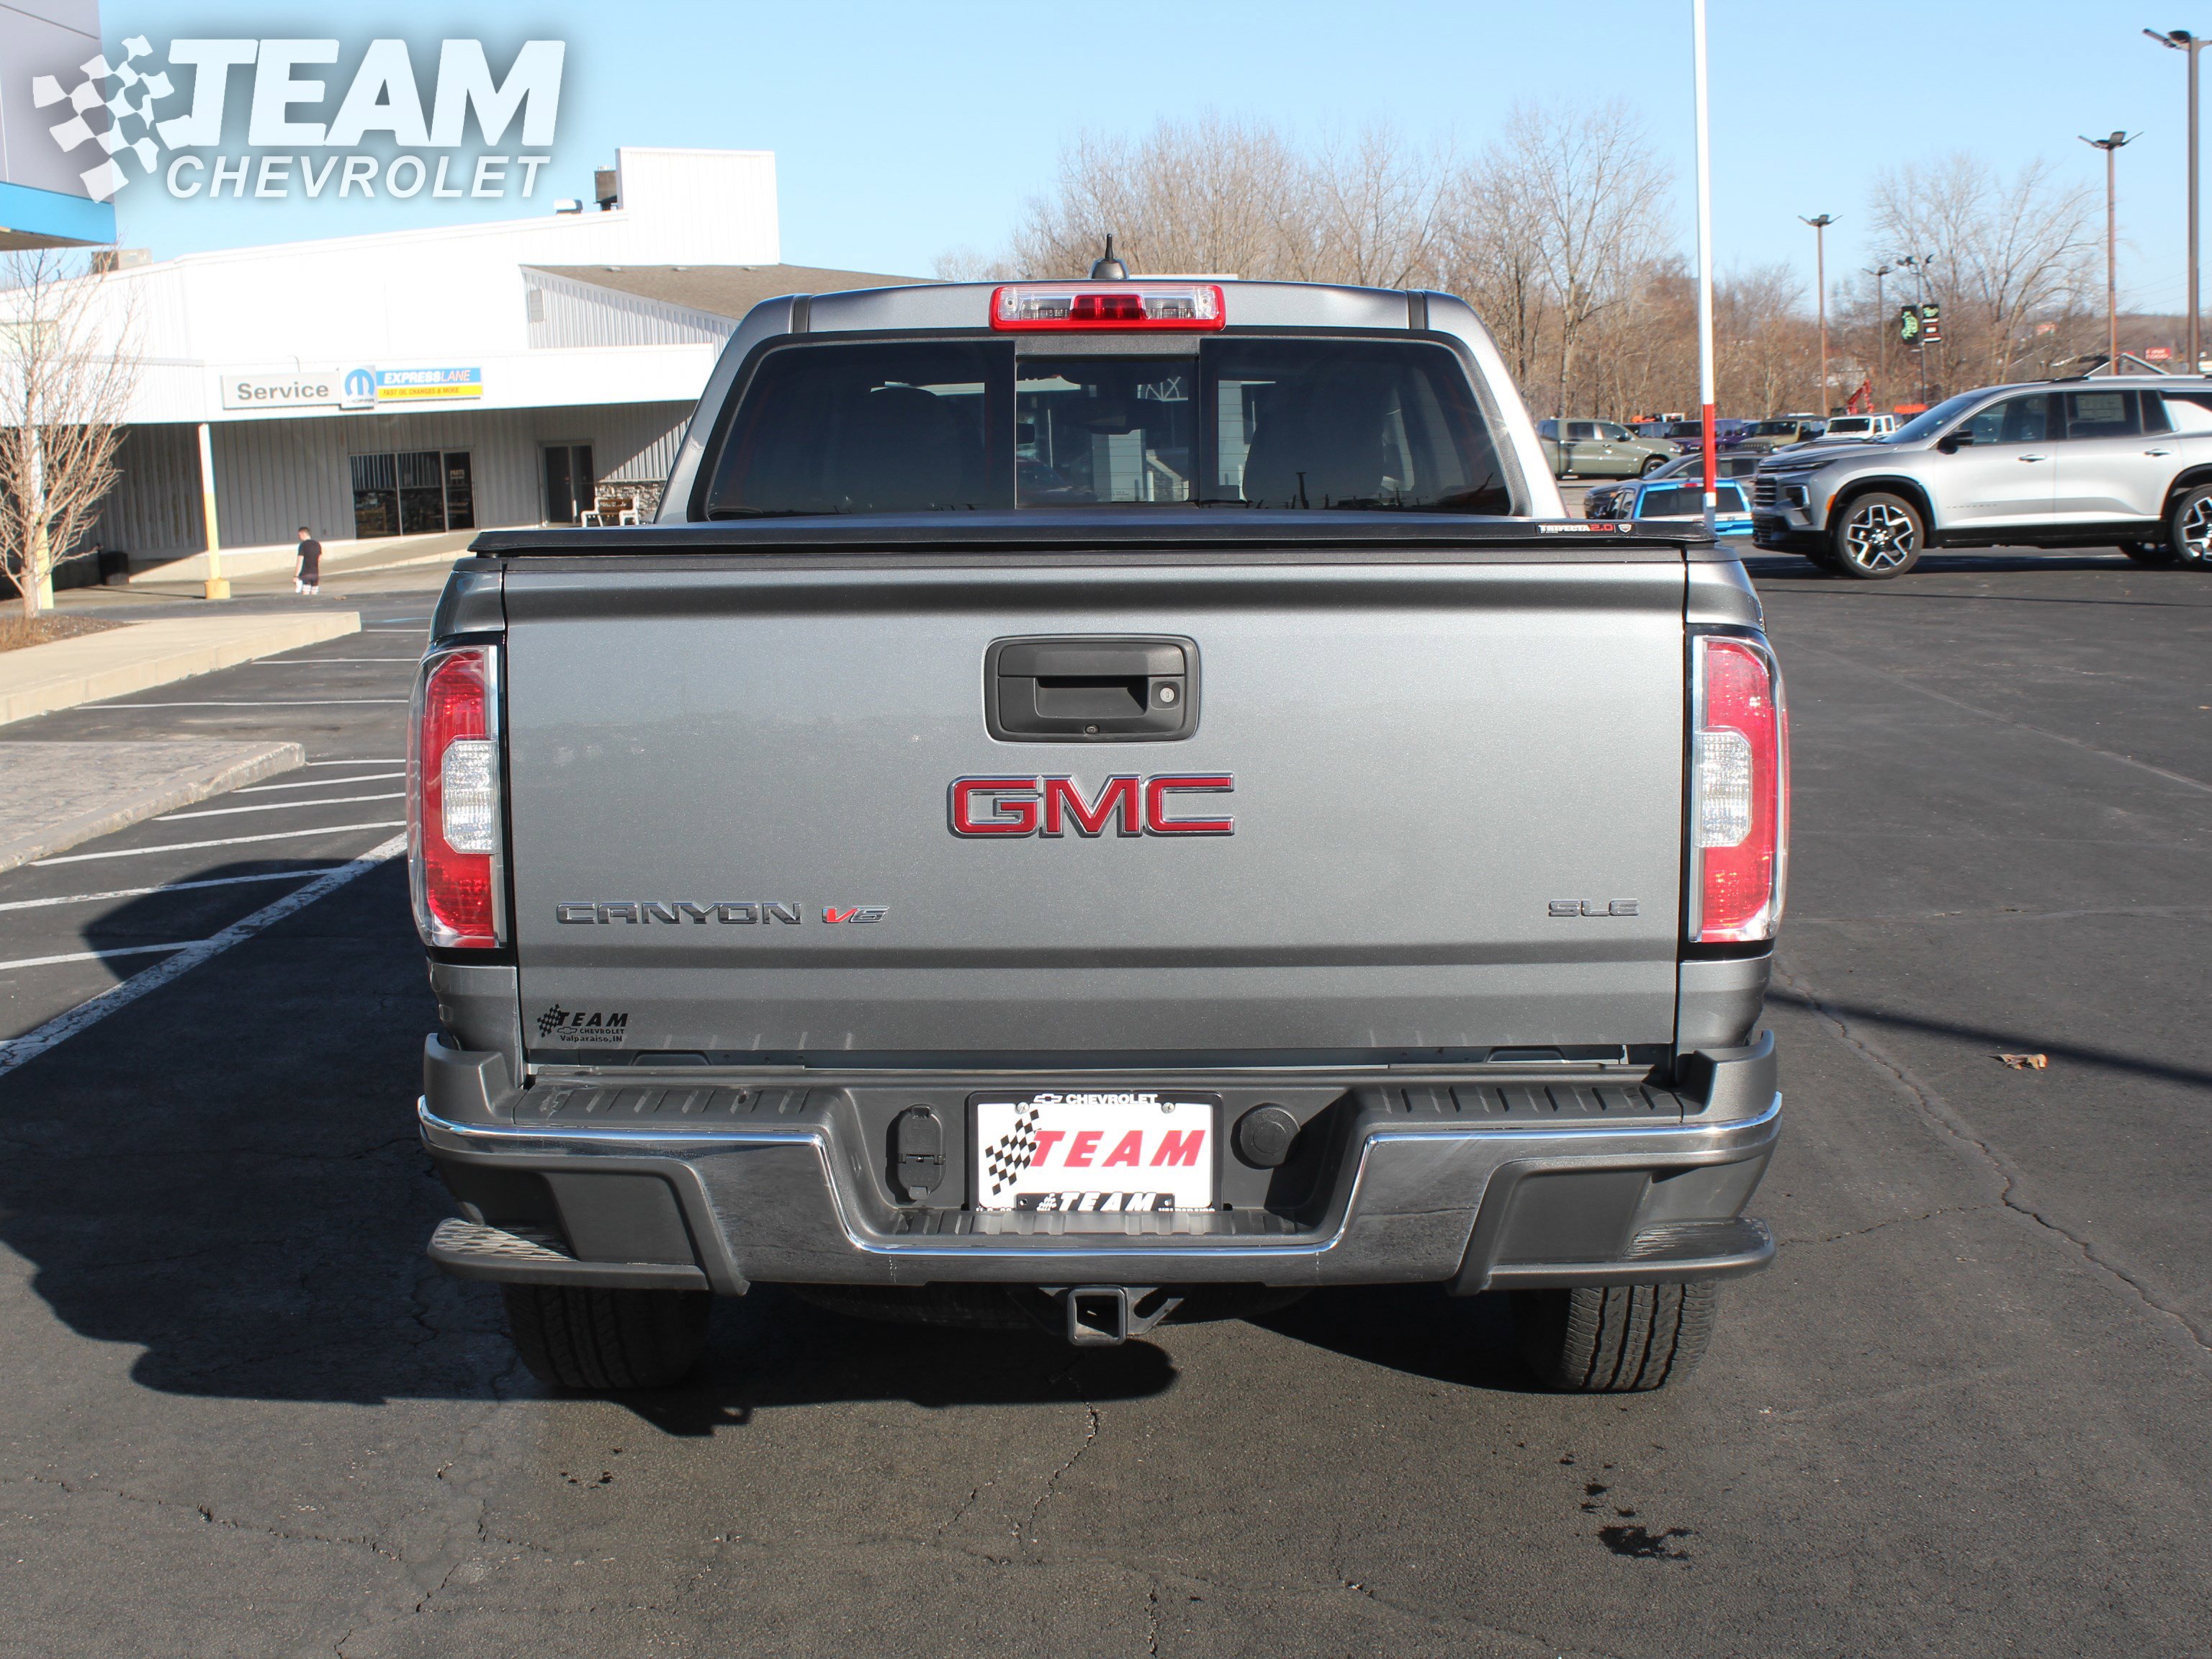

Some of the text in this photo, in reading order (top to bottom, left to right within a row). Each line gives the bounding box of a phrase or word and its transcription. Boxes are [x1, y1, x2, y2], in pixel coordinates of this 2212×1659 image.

[237, 381, 329, 401] Service
[947, 772, 1235, 838] GMC
[556, 901, 890, 925] CANYON V6
[1548, 898, 1639, 917] SLE
[557, 1012, 629, 1028] TEAM
[1066, 1093, 1158, 1106] CHEVROLET
[1030, 1130, 1205, 1167] TEAM
[1058, 1192, 1156, 1212] TEAM
